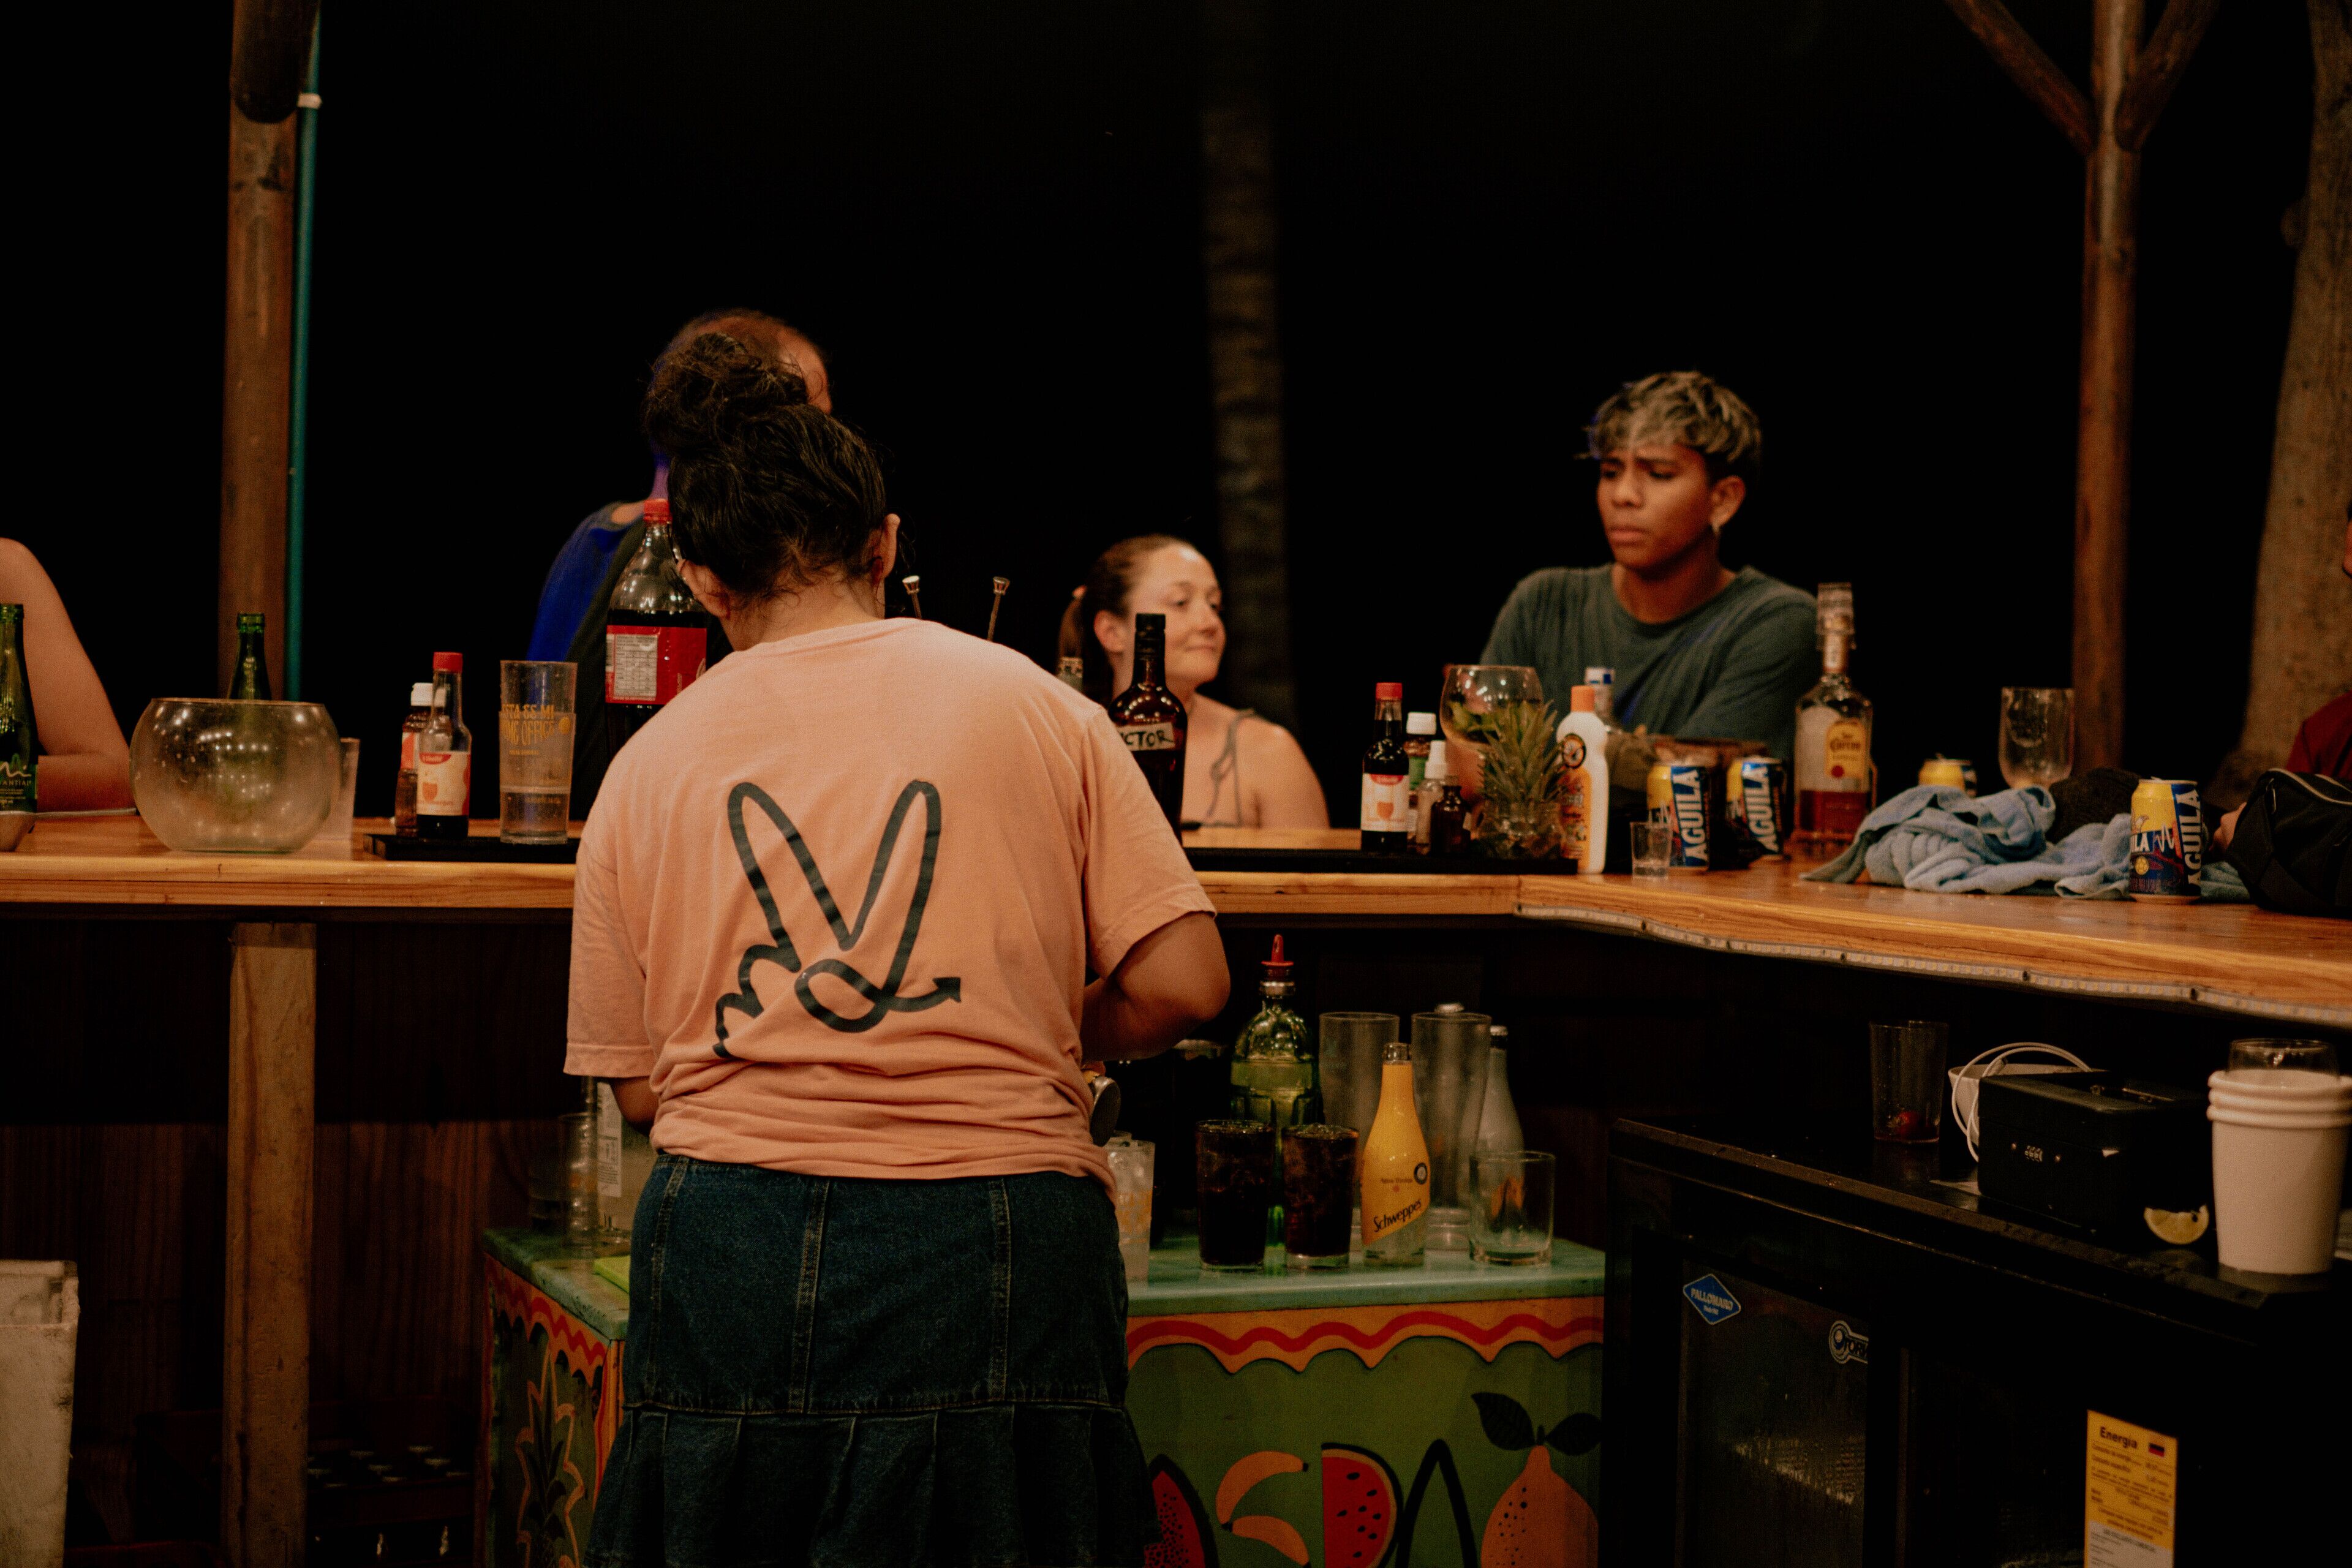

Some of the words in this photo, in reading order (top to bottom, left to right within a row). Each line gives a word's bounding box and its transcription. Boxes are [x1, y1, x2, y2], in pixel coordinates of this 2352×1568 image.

[1672, 767, 1709, 865] AGUILA
[2175, 789, 2201, 886] AGUILA
[1373, 1199, 1422, 1232] Schweppes
